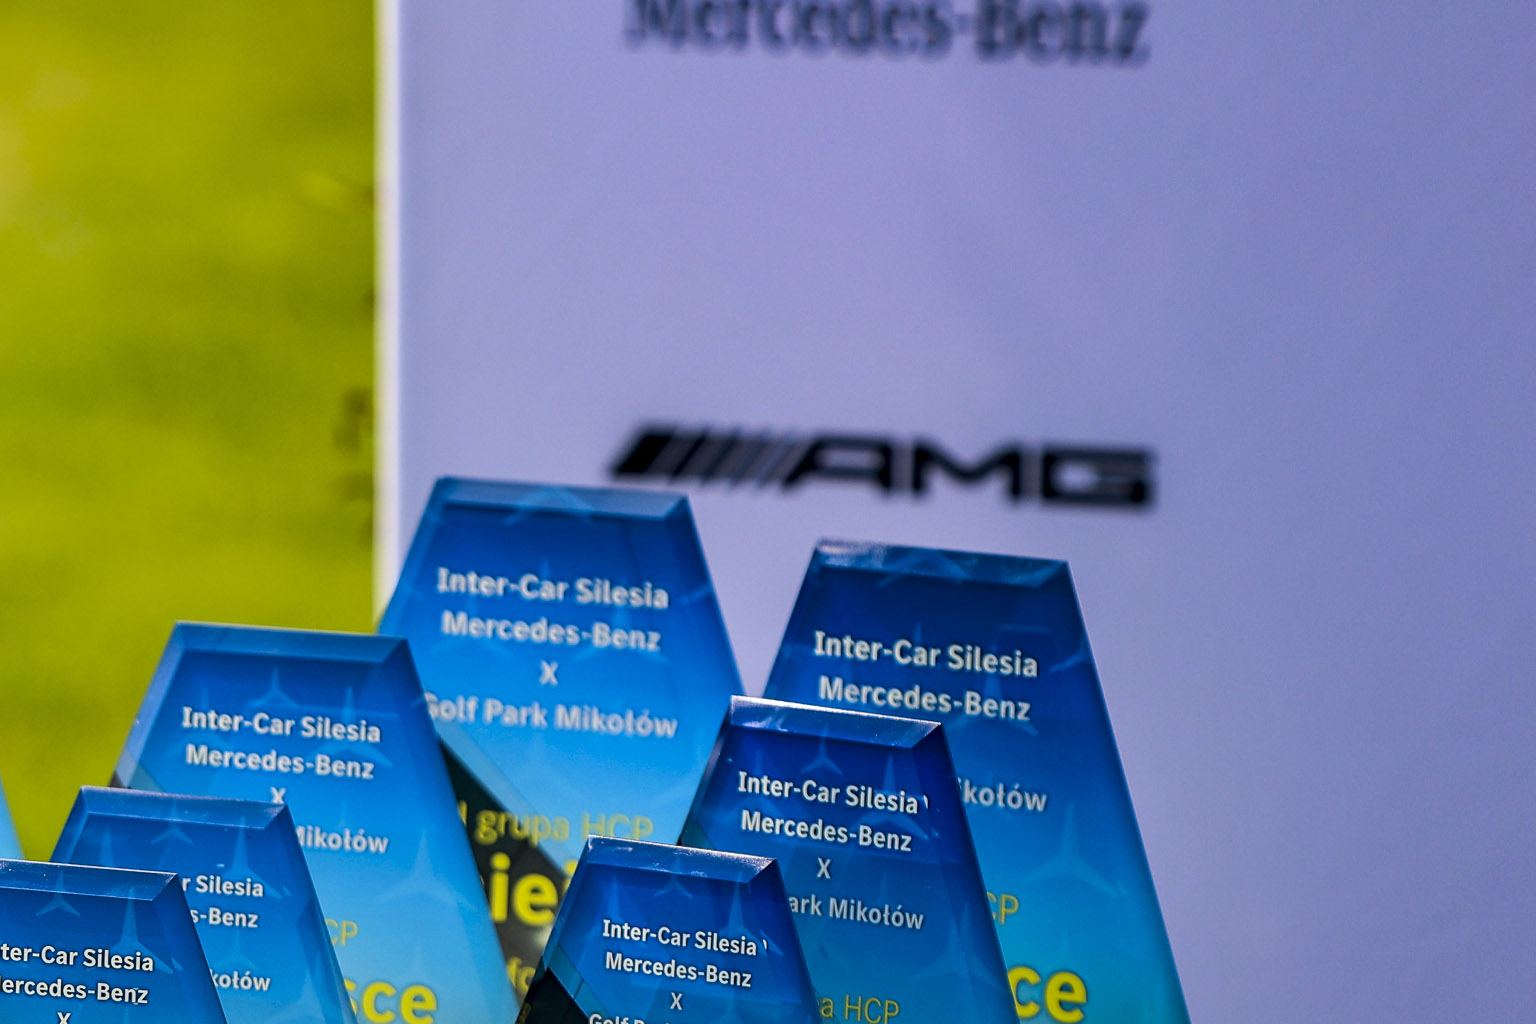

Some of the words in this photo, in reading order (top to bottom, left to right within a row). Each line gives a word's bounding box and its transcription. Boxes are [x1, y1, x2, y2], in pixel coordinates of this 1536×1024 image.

[437, 567, 569, 601] Inter-Car
[575, 578, 670, 609] Silesia
[441, 610, 662, 653] Mercedes-Benz
[814, 630, 941, 667] Inter-Car
[948, 644, 1039, 678] Silesia
[539, 660, 559, 686] X
[819, 675, 1031, 722] Mercedes-Benz
[182, 706, 295, 736] Inter-Car
[301, 716, 381, 743] Silesia
[484, 698, 548, 729] Park
[554, 703, 678, 739] Mikołów
[186, 744, 375, 780] Mercedes-Benz
[738, 771, 840, 804] Inter-Car
[845, 785, 918, 814] Silesia
[475, 808, 570, 846] grupa
[741, 809, 912, 852] Mercedes-Benz
[195, 876, 264, 898] Silesia
[817, 858, 831, 879] X
[788, 894, 822, 916] ark
[829, 897, 924, 930] Mikołów
[602, 919, 691, 947] Inter-Car
[694, 930, 757, 956] Silesia
[82, 949, 154, 972] Silesia
[605, 951, 752, 988] Mercedes-Benz
[670, 992, 683, 1011] X
